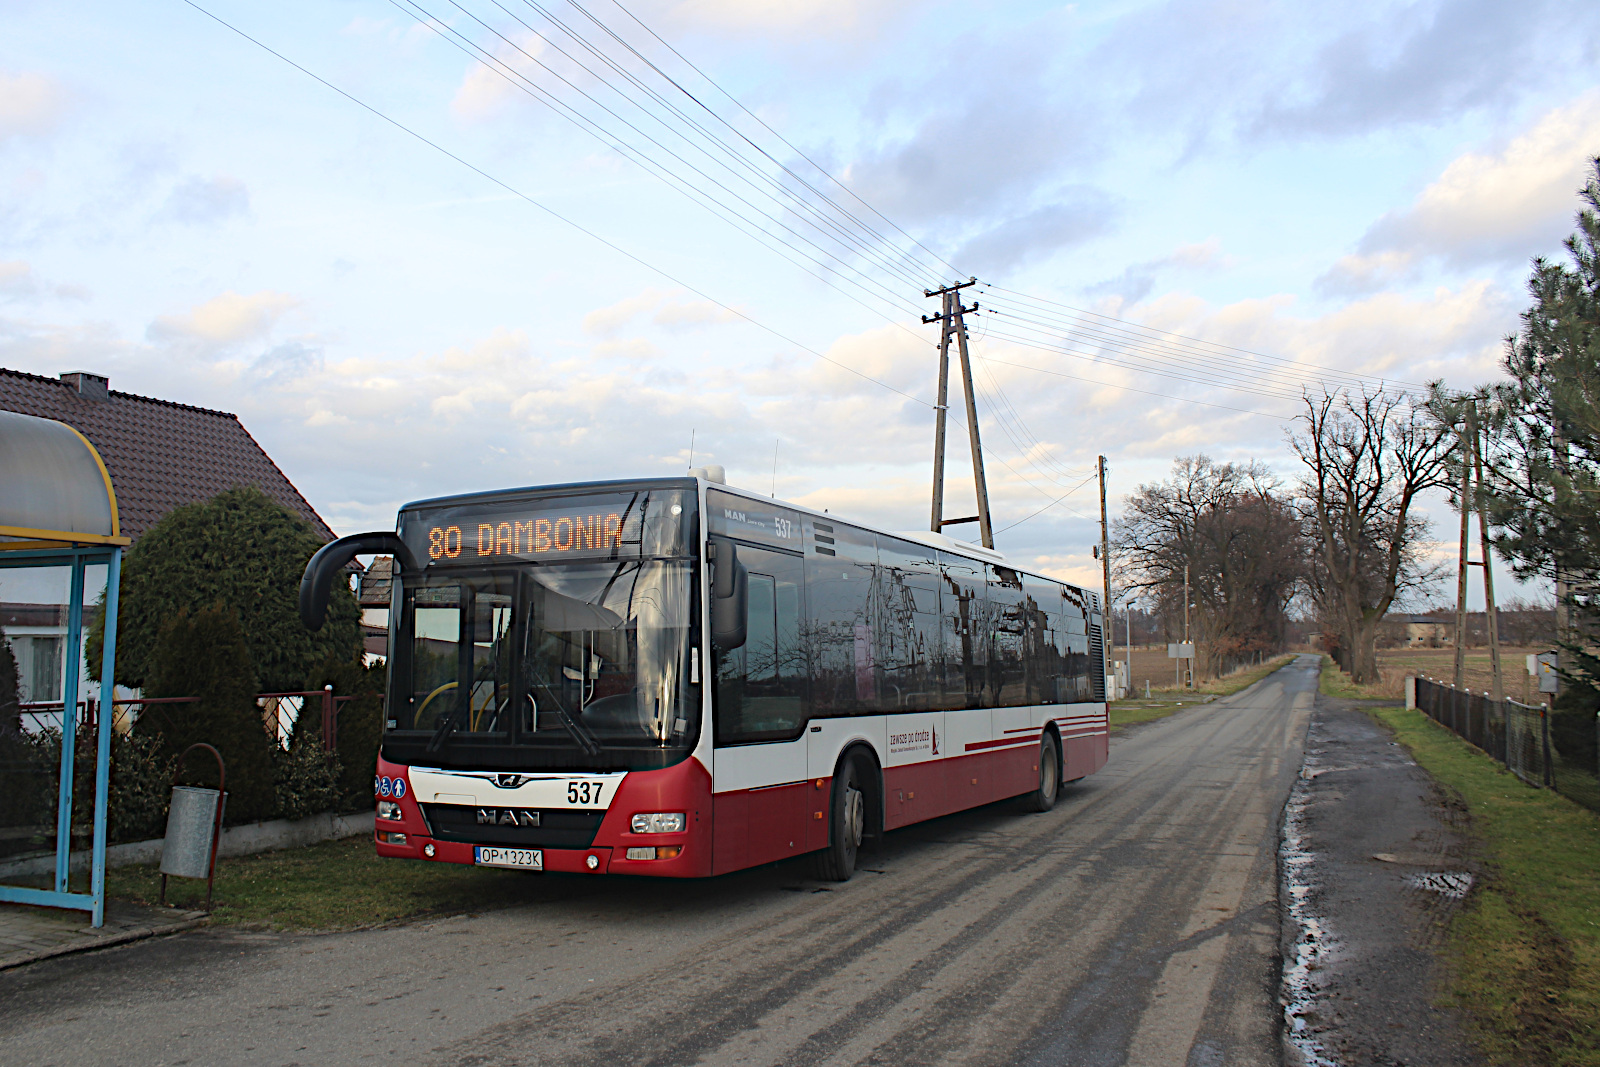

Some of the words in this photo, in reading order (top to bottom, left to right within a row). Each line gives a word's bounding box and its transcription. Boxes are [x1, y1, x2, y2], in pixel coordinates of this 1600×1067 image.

[724, 508, 746, 522] MAN
[428, 526, 462, 559] 80
[477, 513, 622, 556] DAMBONIA
[774, 516, 791, 539] 537
[567, 781, 604, 804] 537
[476, 809, 540, 826] MAN
